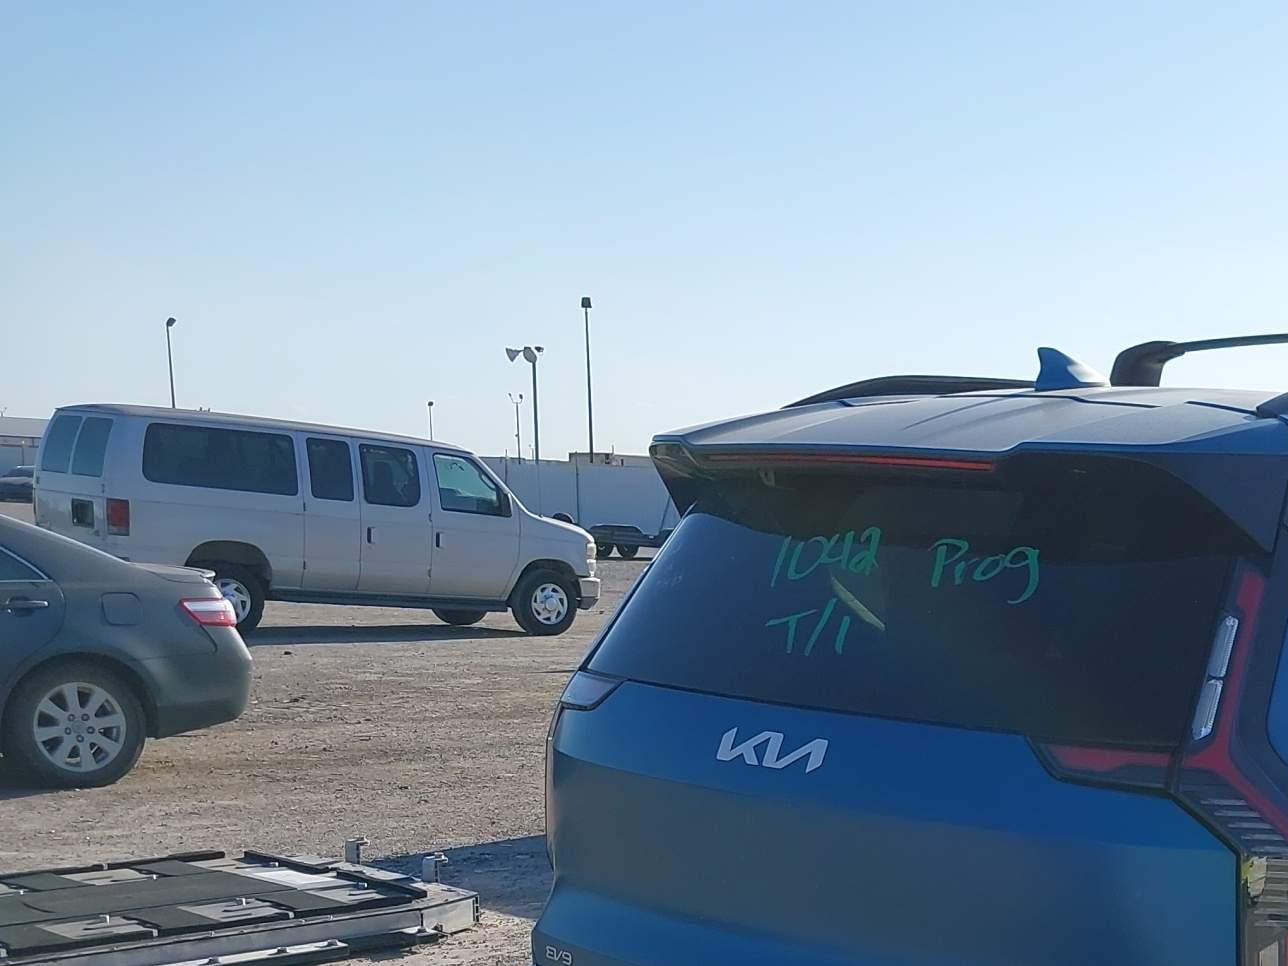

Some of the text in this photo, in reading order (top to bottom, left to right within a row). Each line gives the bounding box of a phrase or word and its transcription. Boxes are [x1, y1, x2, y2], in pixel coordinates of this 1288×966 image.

[770, 526, 1040, 604] 1042 Prog
[716, 726, 829, 773] KIA
[545, 945, 573, 966] EV9
